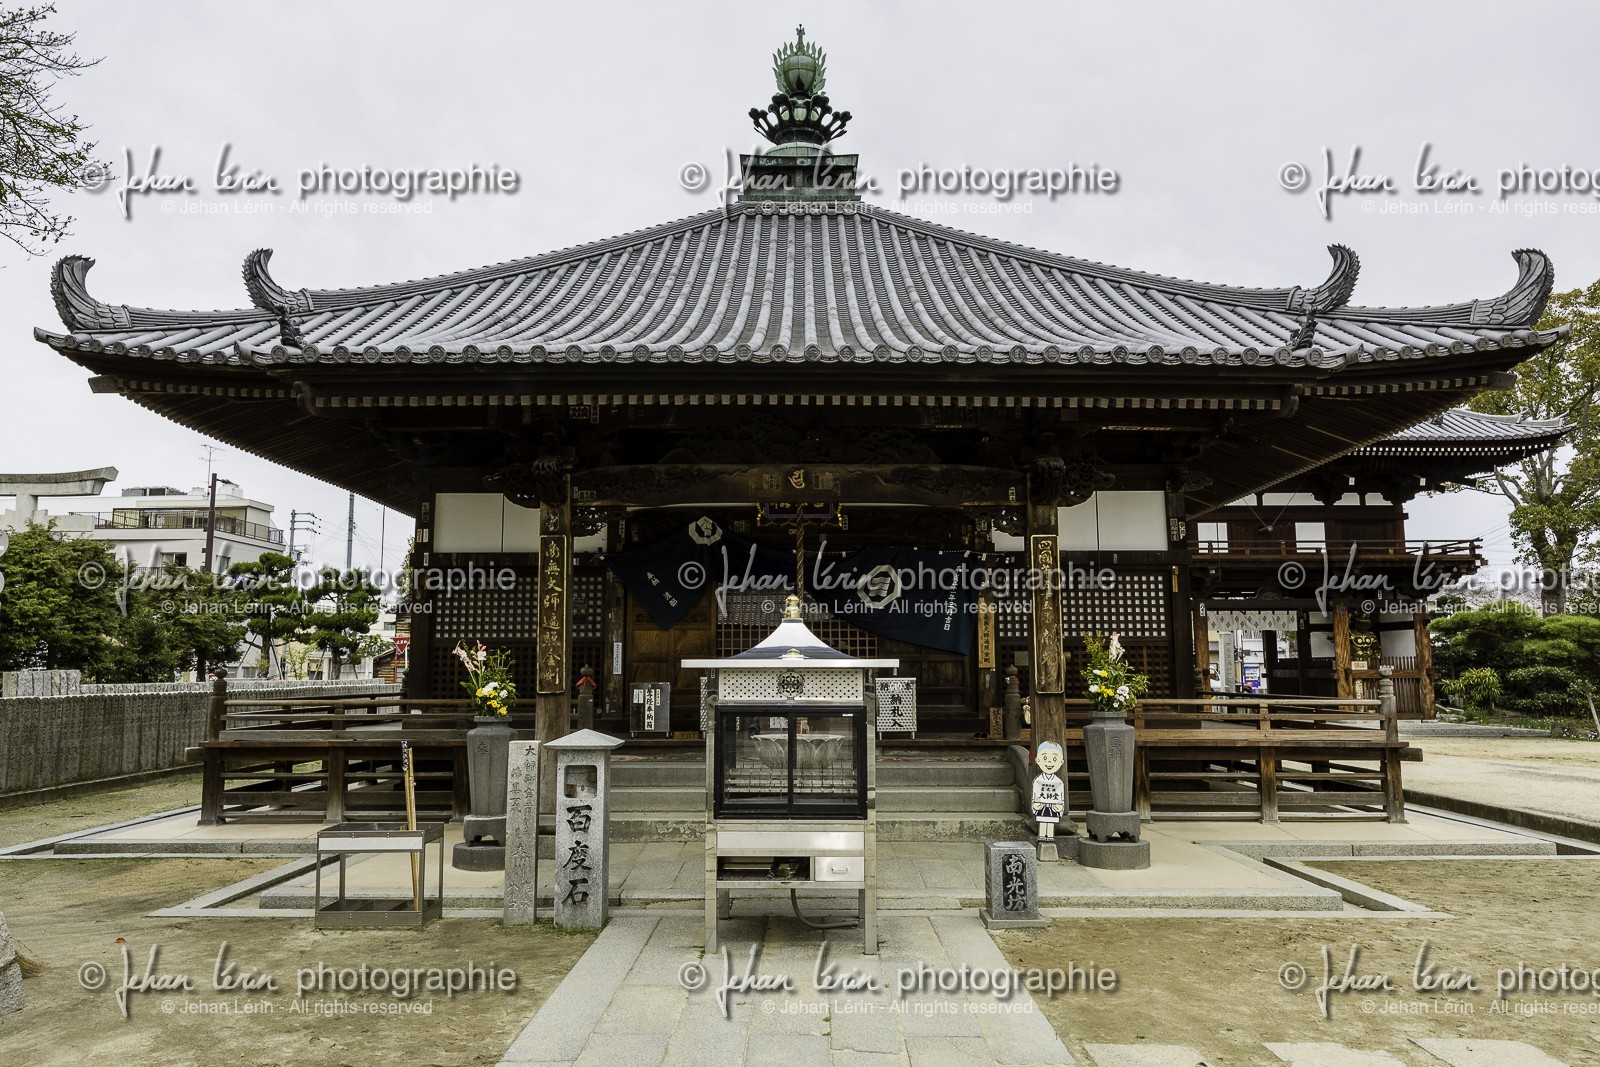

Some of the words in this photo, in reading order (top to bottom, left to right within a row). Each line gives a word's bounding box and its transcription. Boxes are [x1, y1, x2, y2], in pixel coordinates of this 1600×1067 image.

[890, 694, 904, 727] 納札入
[562, 804, 592, 906] 百度石
[1005, 854, 1025, 911] 南光坊
